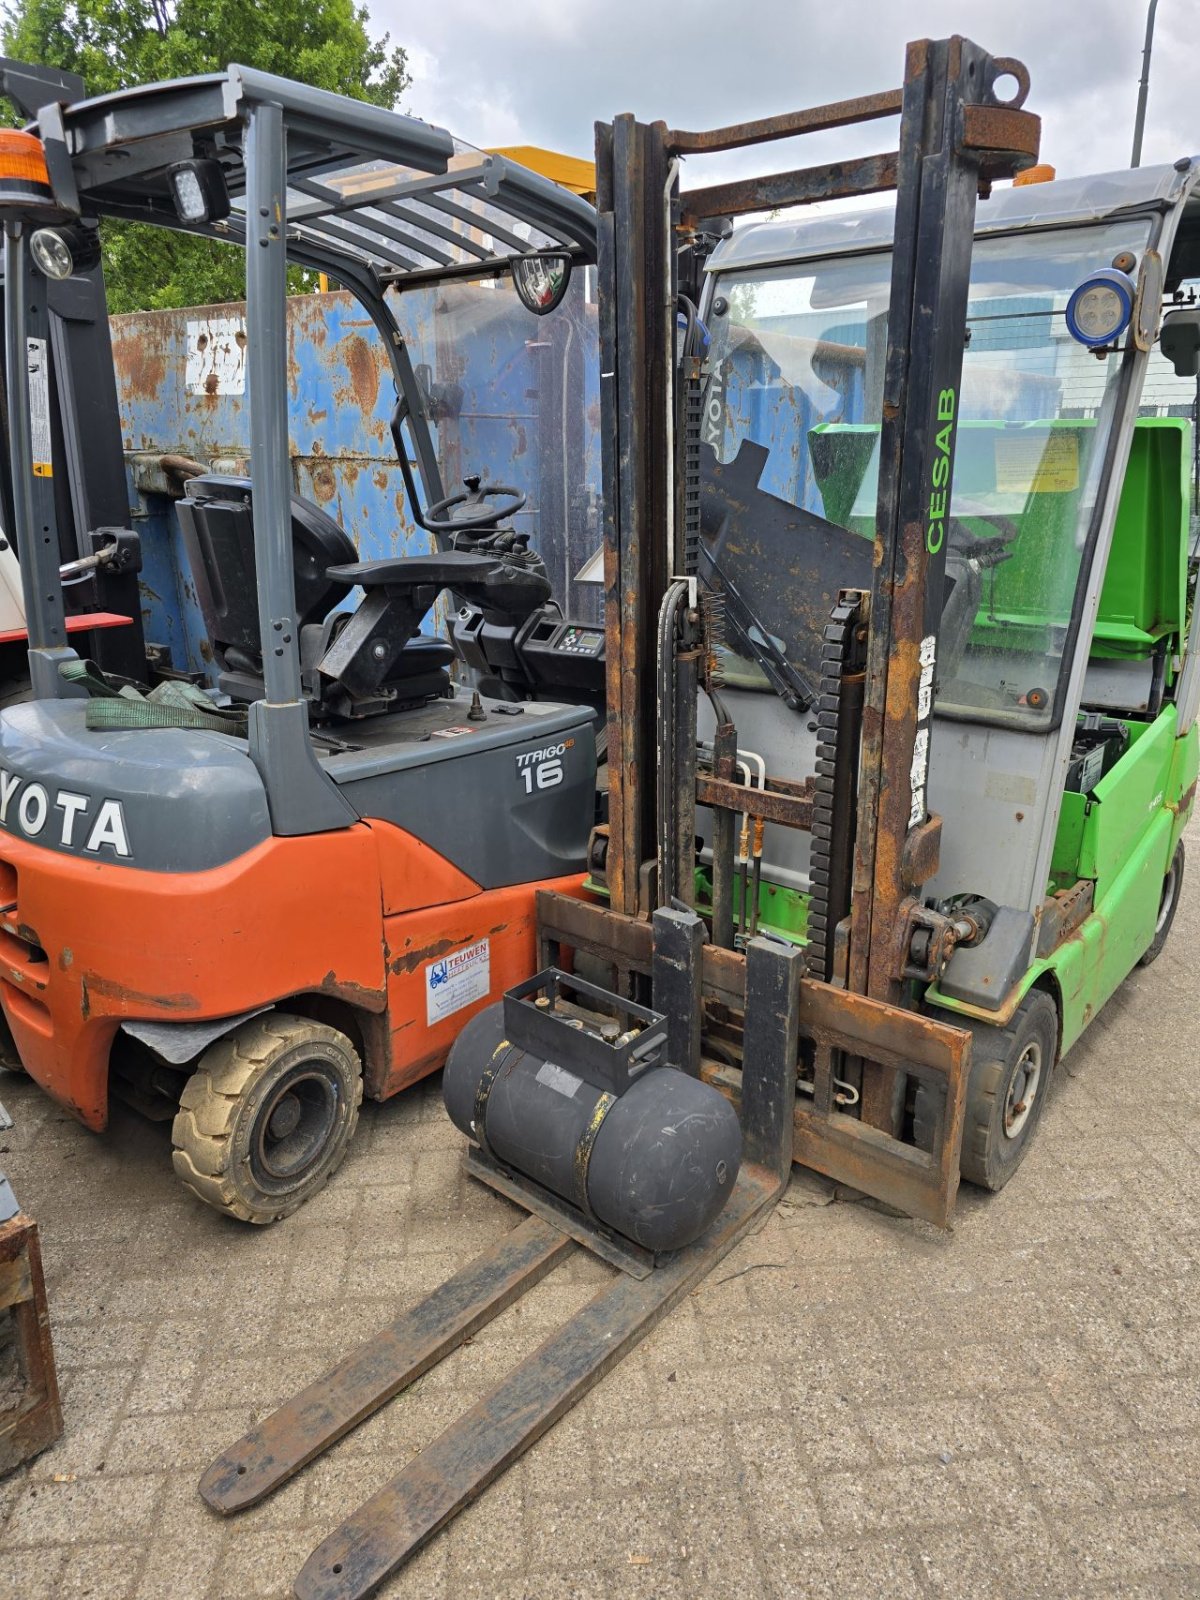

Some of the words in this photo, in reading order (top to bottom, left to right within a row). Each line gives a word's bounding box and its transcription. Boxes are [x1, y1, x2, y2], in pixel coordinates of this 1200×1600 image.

[927, 388, 955, 554] CESAB
[516, 743, 566, 767] TRAIGO
[521, 758, 563, 793] 16
[449, 943, 487, 968] TEUWEN
